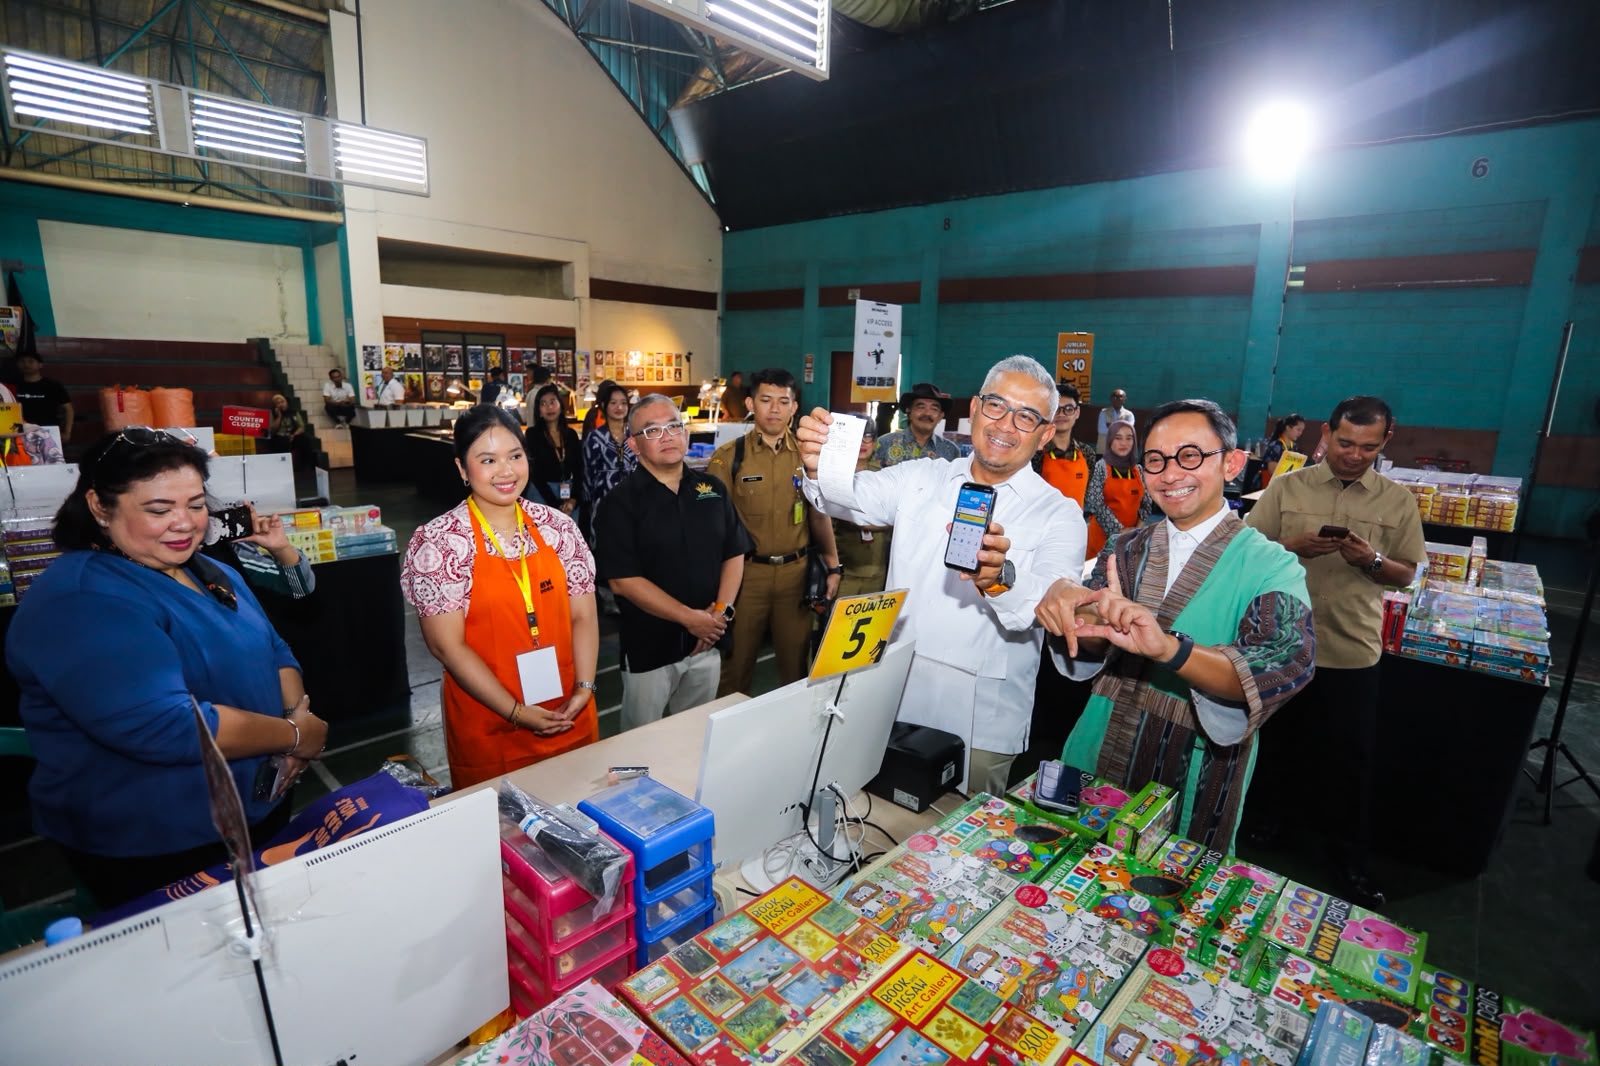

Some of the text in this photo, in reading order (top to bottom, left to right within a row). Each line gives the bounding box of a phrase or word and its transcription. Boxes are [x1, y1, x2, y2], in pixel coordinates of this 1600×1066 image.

[1472, 157, 1489, 178] 6
[944, 217, 951, 230] 8
[845, 598, 896, 616] COUNTER
[842, 616, 872, 660] 5
[334, 797, 358, 821] WOLF
[940, 810, 988, 846] bingo
[1052, 860, 1098, 902] bingo
[752, 898, 780, 918] BOOK
[762, 899, 796, 924] JIGSAW
[770, 894, 820, 930] Art Gallery
[1324, 900, 1349, 928] pairs
[864, 936, 892, 960] 300
[876, 944, 900, 964] PIECES
[880, 977, 911, 1004] BOOK
[894, 978, 928, 1012] JIGSAW
[904, 1002, 924, 1019] Art
[920, 972, 954, 1002] Gallery
[1476, 988, 1501, 1024] pairs
[1018, 1026, 1048, 1056] 300
[1036, 1036, 1058, 1062] PIECES
